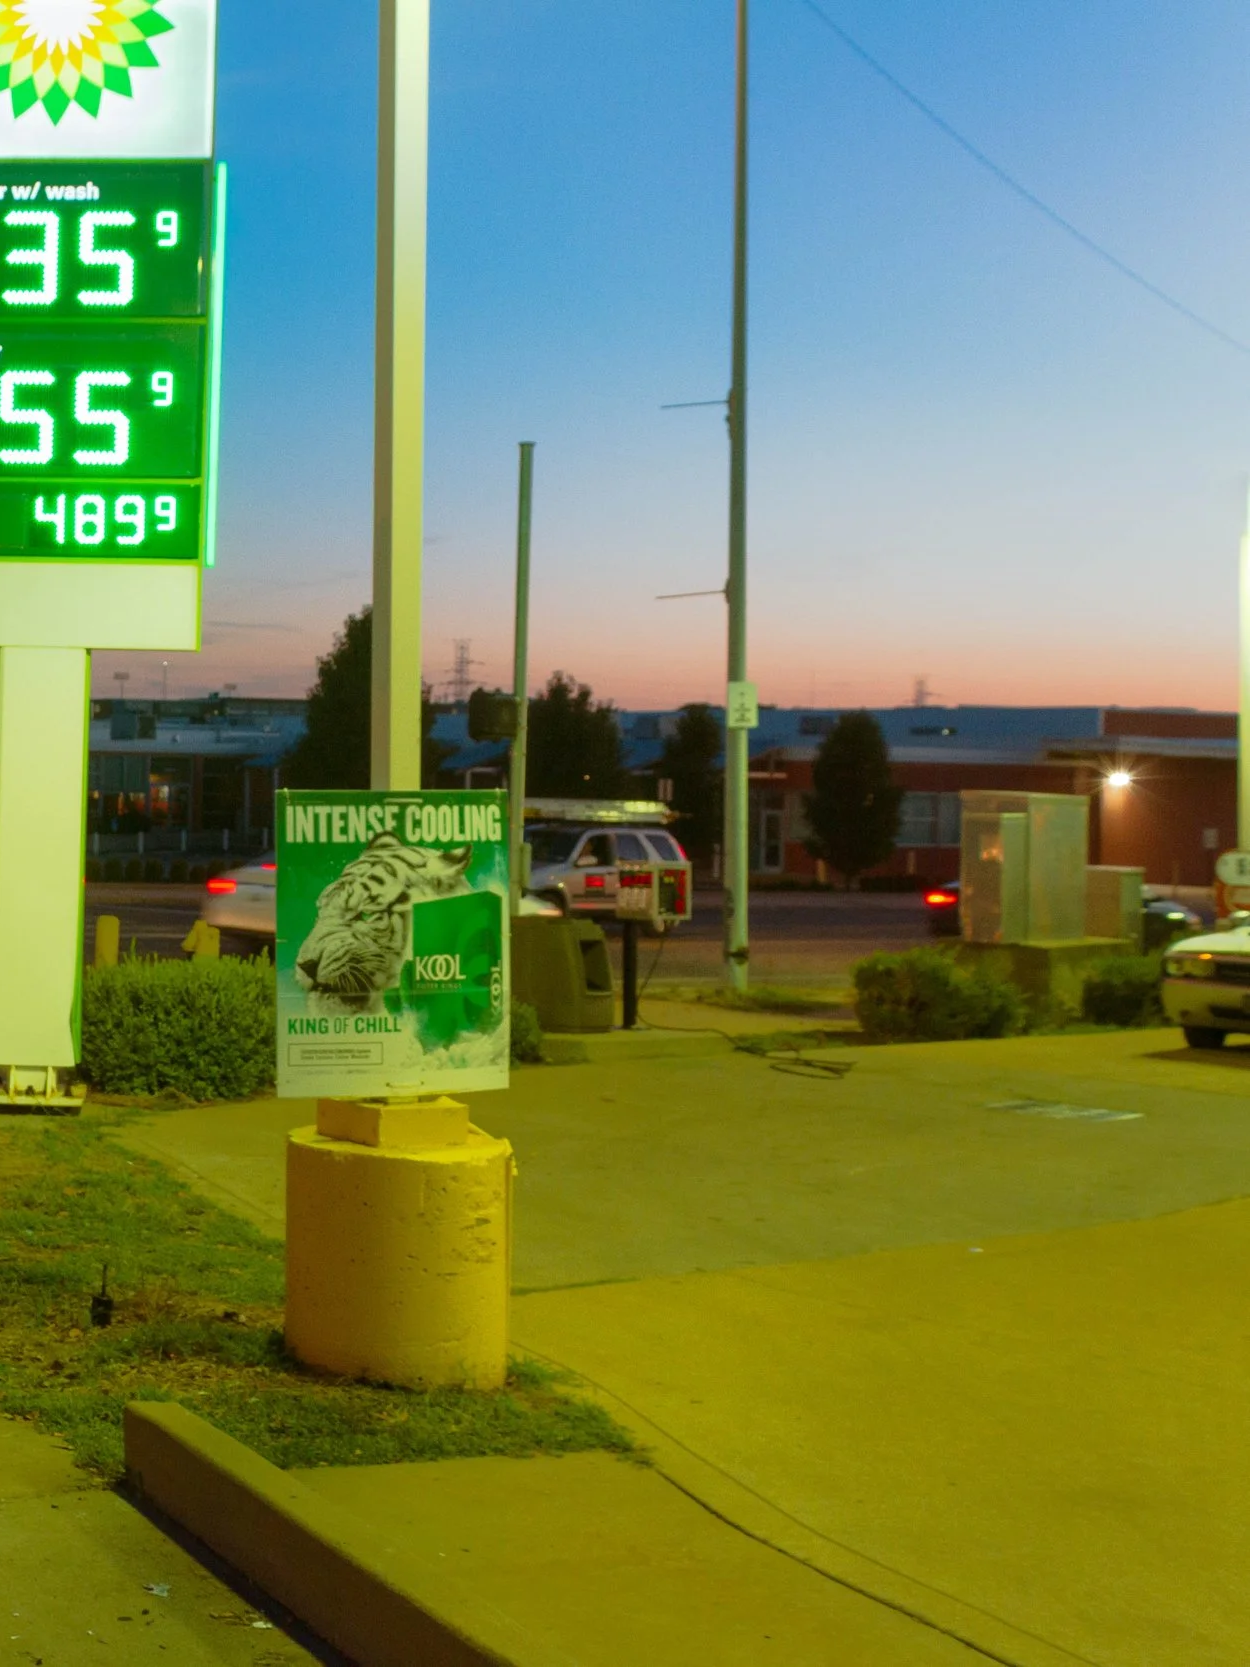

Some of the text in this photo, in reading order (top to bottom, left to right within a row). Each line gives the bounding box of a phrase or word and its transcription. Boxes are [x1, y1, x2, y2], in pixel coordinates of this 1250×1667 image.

[11, 182, 41, 200] w/
[45, 182, 100, 201] wash
[286, 804, 502, 844] INTENSE COOLING
[415, 953, 467, 981] KOOL
[288, 1014, 403, 1035] KING OF CHILL
